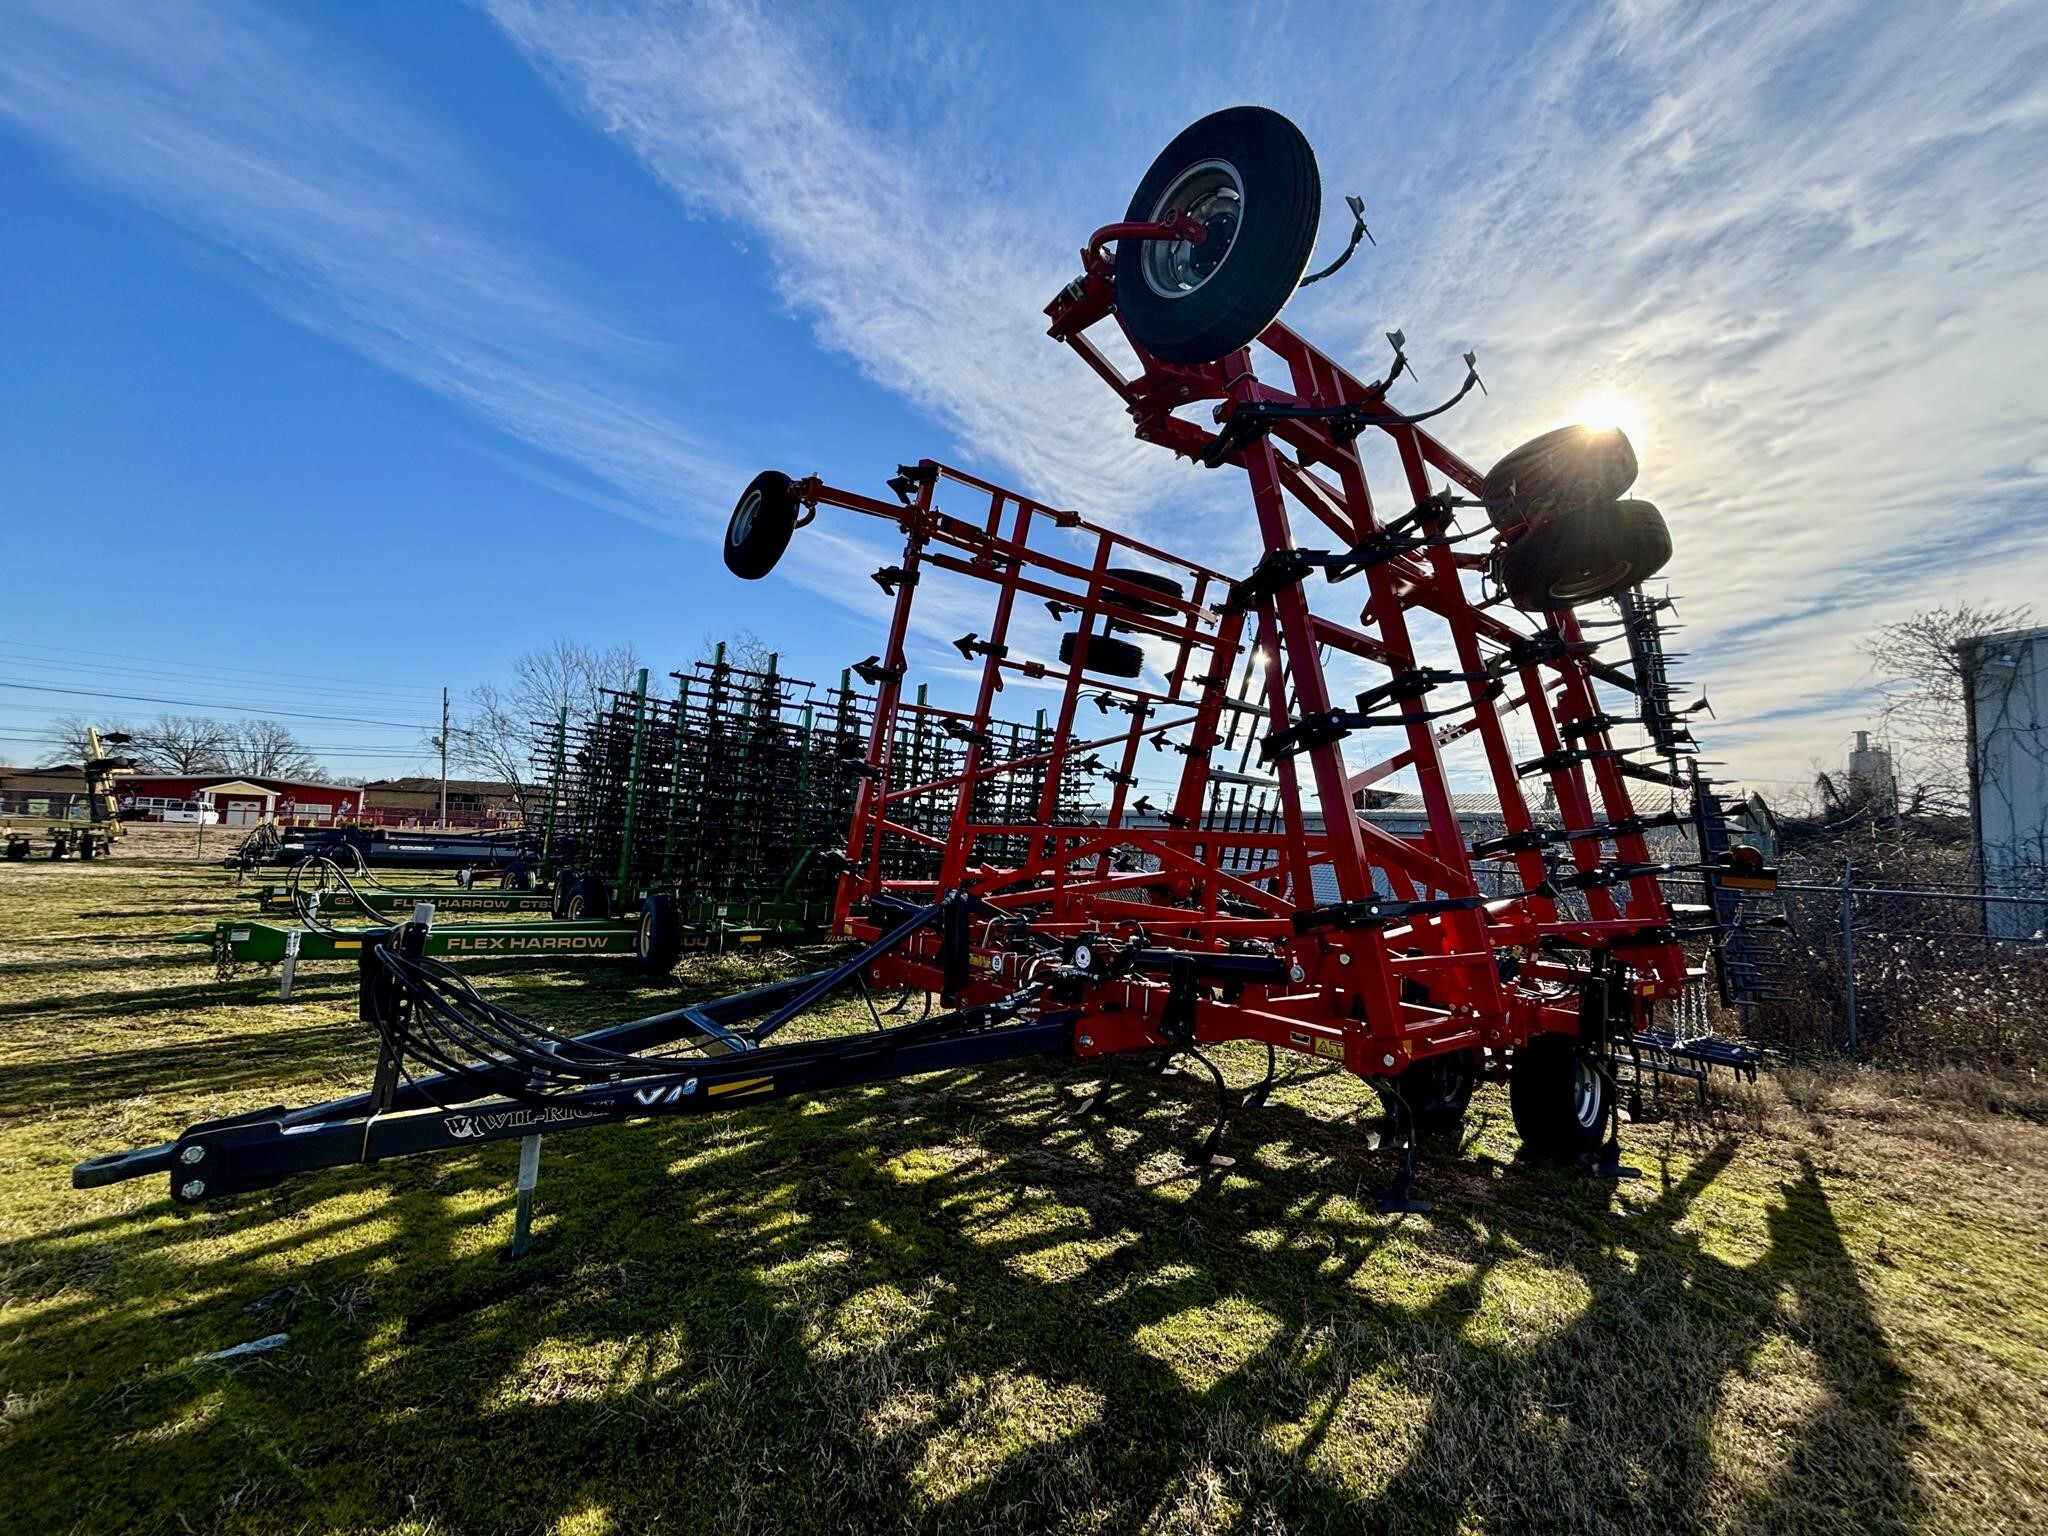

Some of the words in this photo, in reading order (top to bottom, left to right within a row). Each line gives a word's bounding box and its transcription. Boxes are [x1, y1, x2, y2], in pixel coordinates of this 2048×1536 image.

[438, 899, 510, 909] HARROW
[519, 900, 553, 910] CT8
[447, 937, 505, 950] FLEX
[509, 936, 608, 950] HARROW
